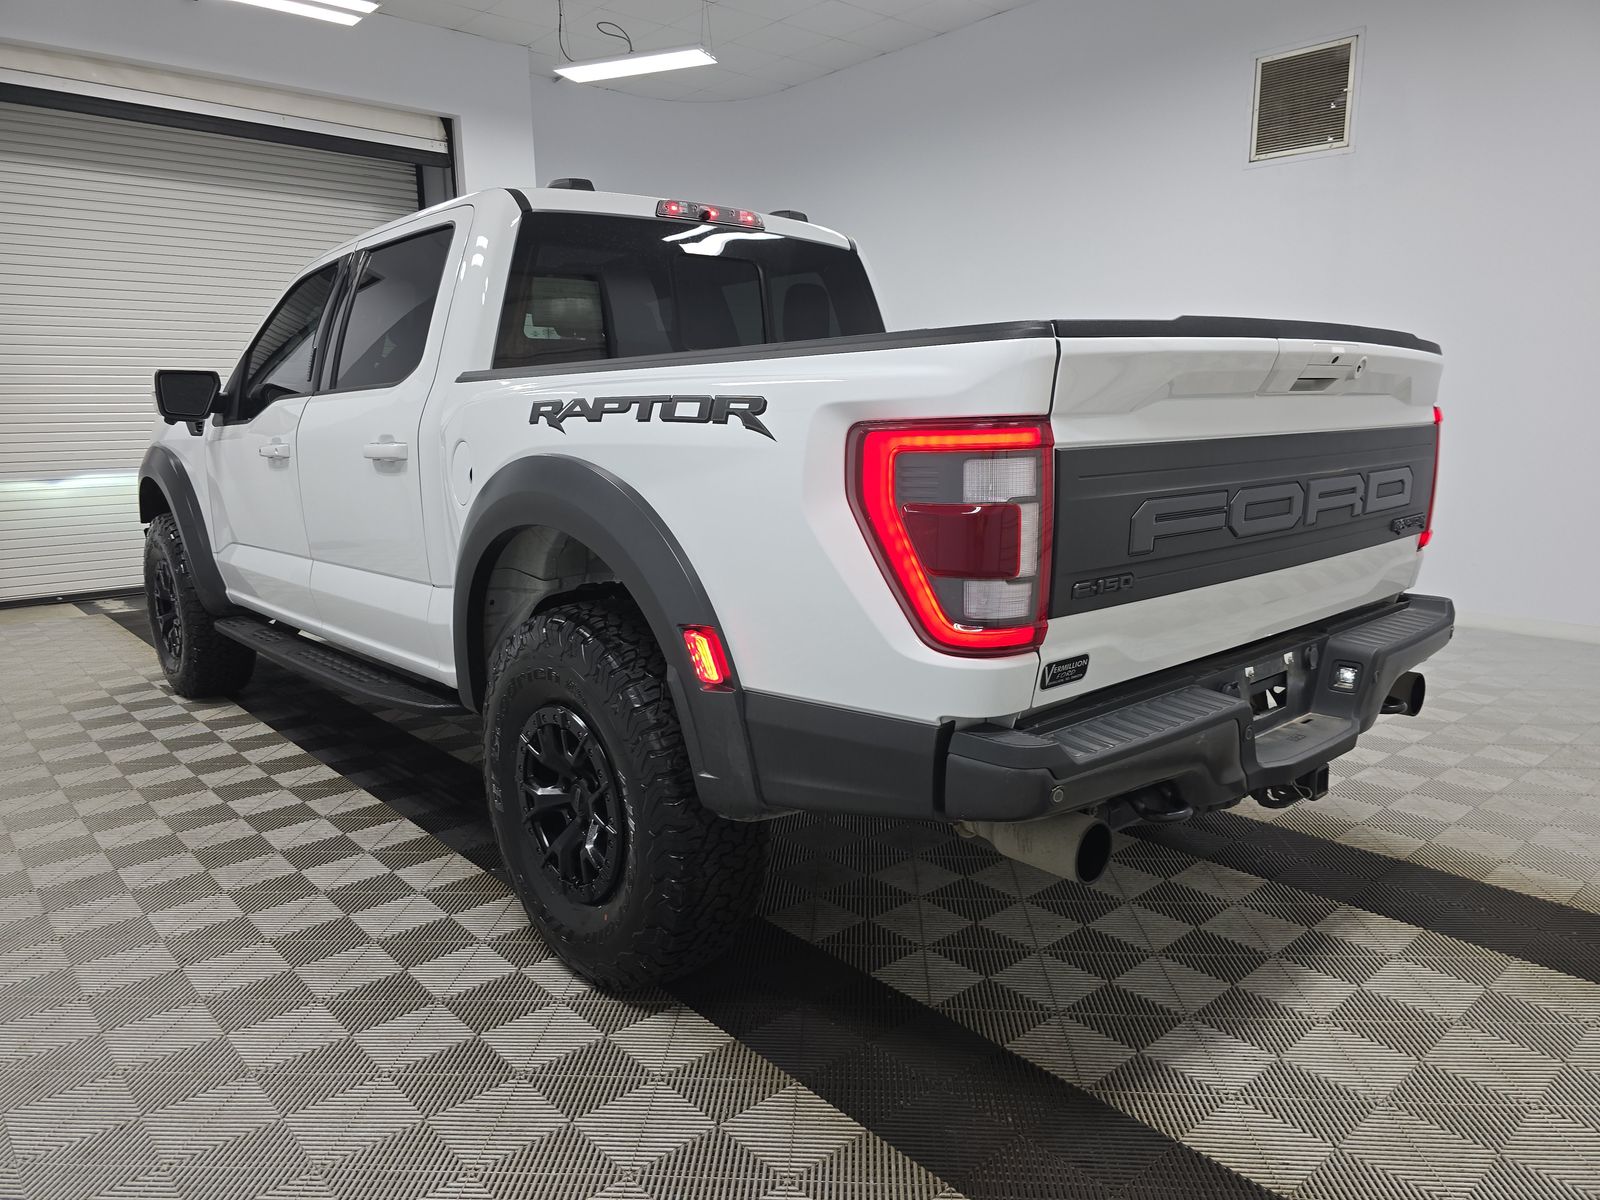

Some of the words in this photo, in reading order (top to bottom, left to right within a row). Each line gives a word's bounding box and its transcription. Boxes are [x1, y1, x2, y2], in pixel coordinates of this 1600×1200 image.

[529, 395, 777, 442] RAPTOR
[1128, 466, 1415, 556] FORD
[1072, 573, 1134, 600] F-150
[1045, 659, 1088, 687] VERMILLION
